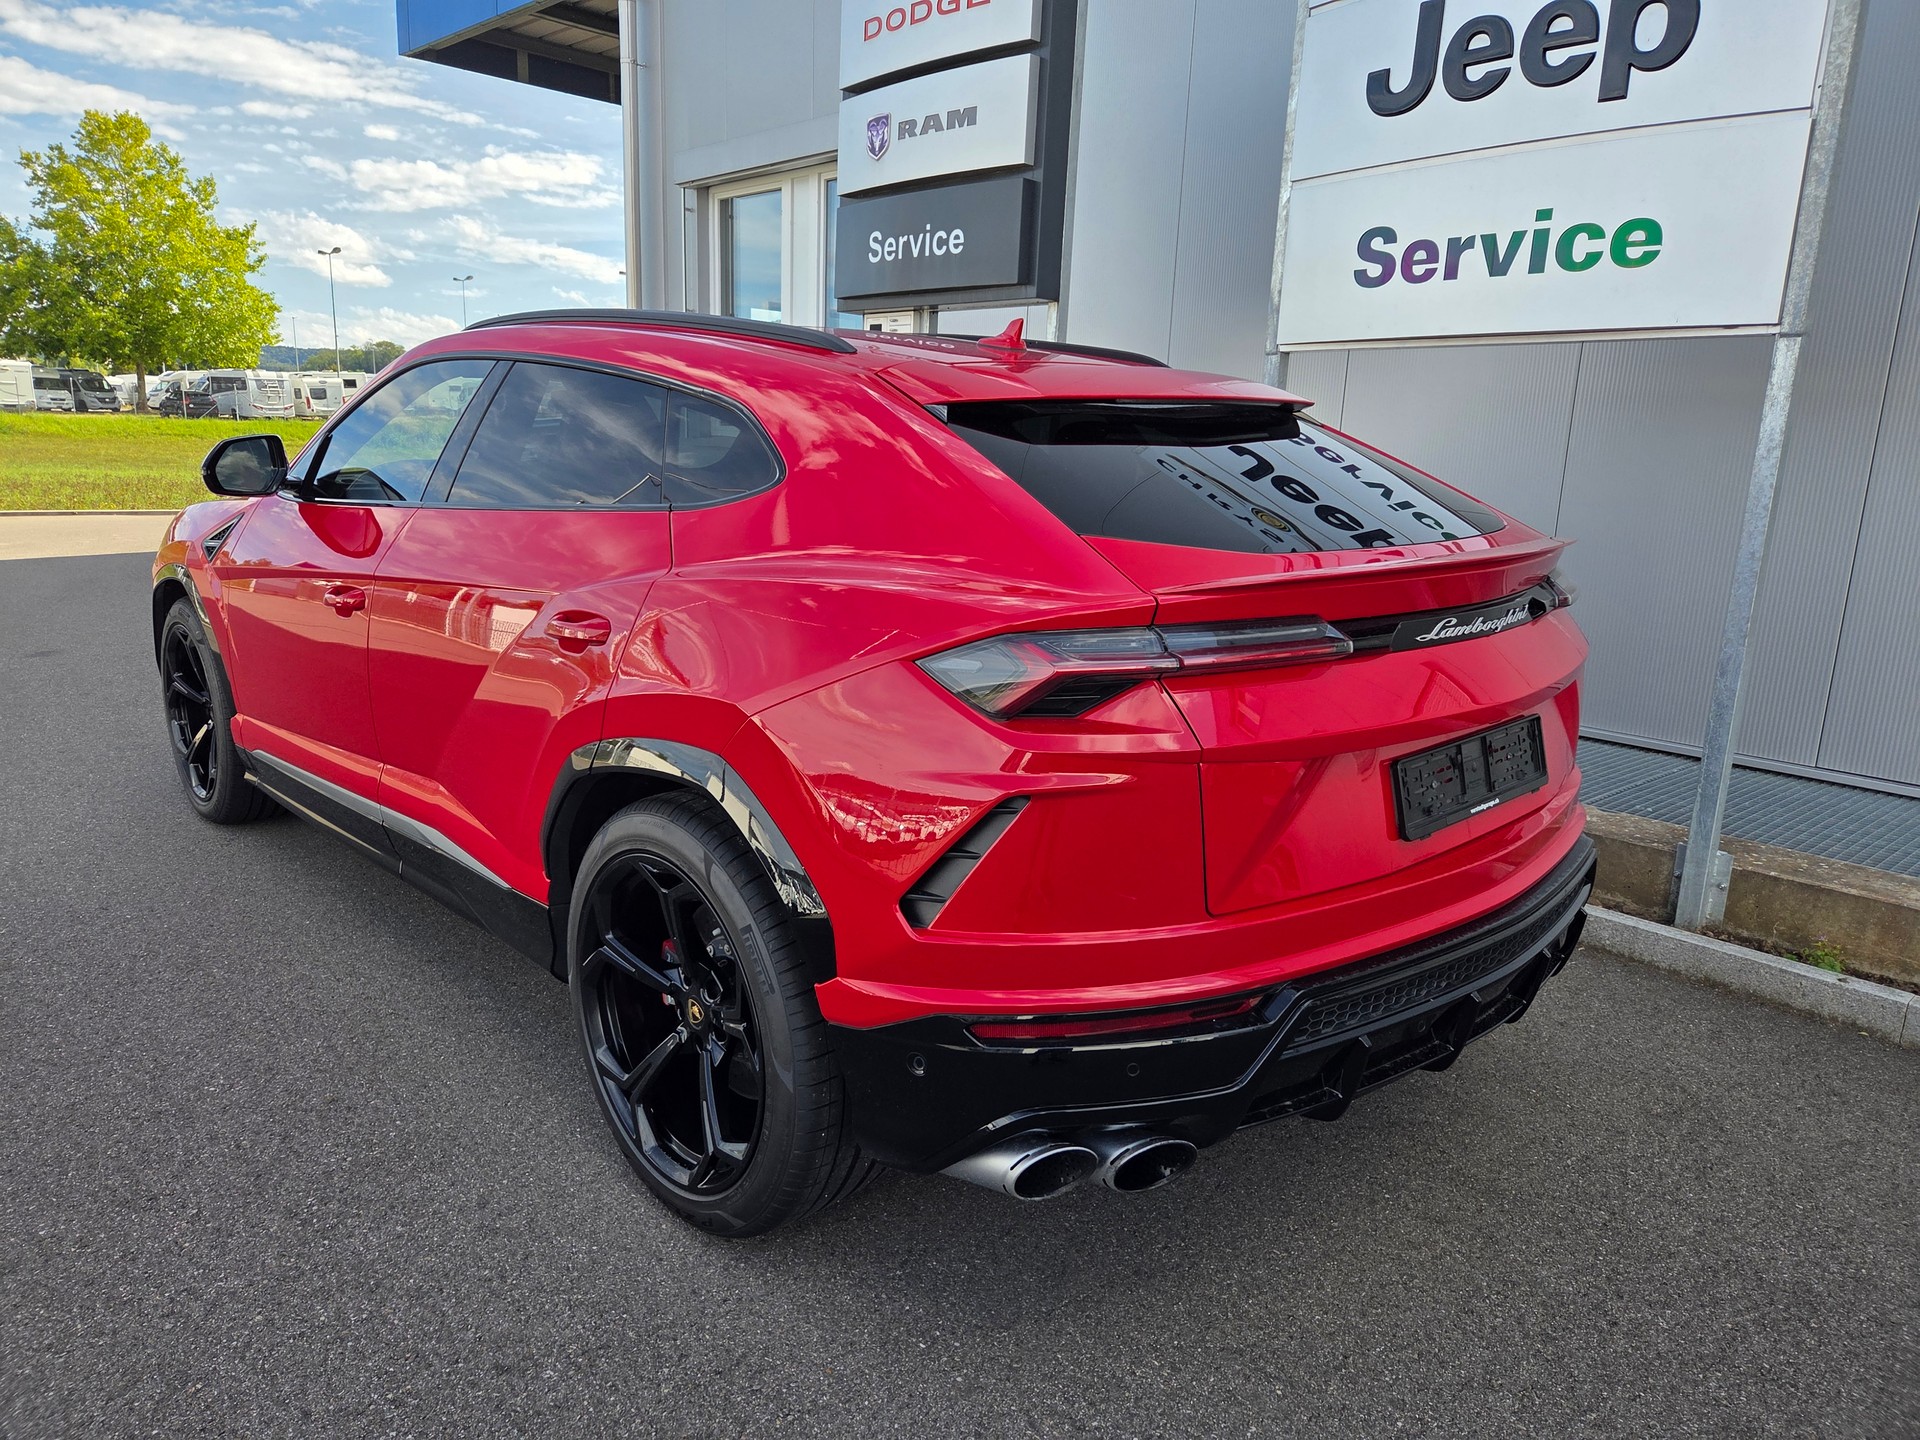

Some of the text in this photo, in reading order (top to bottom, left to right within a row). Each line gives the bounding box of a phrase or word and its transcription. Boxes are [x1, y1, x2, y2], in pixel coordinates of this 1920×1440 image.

[1366, 0, 1700, 117] Jeep
[897, 106, 978, 141] RAM
[868, 223, 965, 263] Service
[1353, 207, 1663, 288] Service
[1415, 603, 1530, 642] Lamborghini
